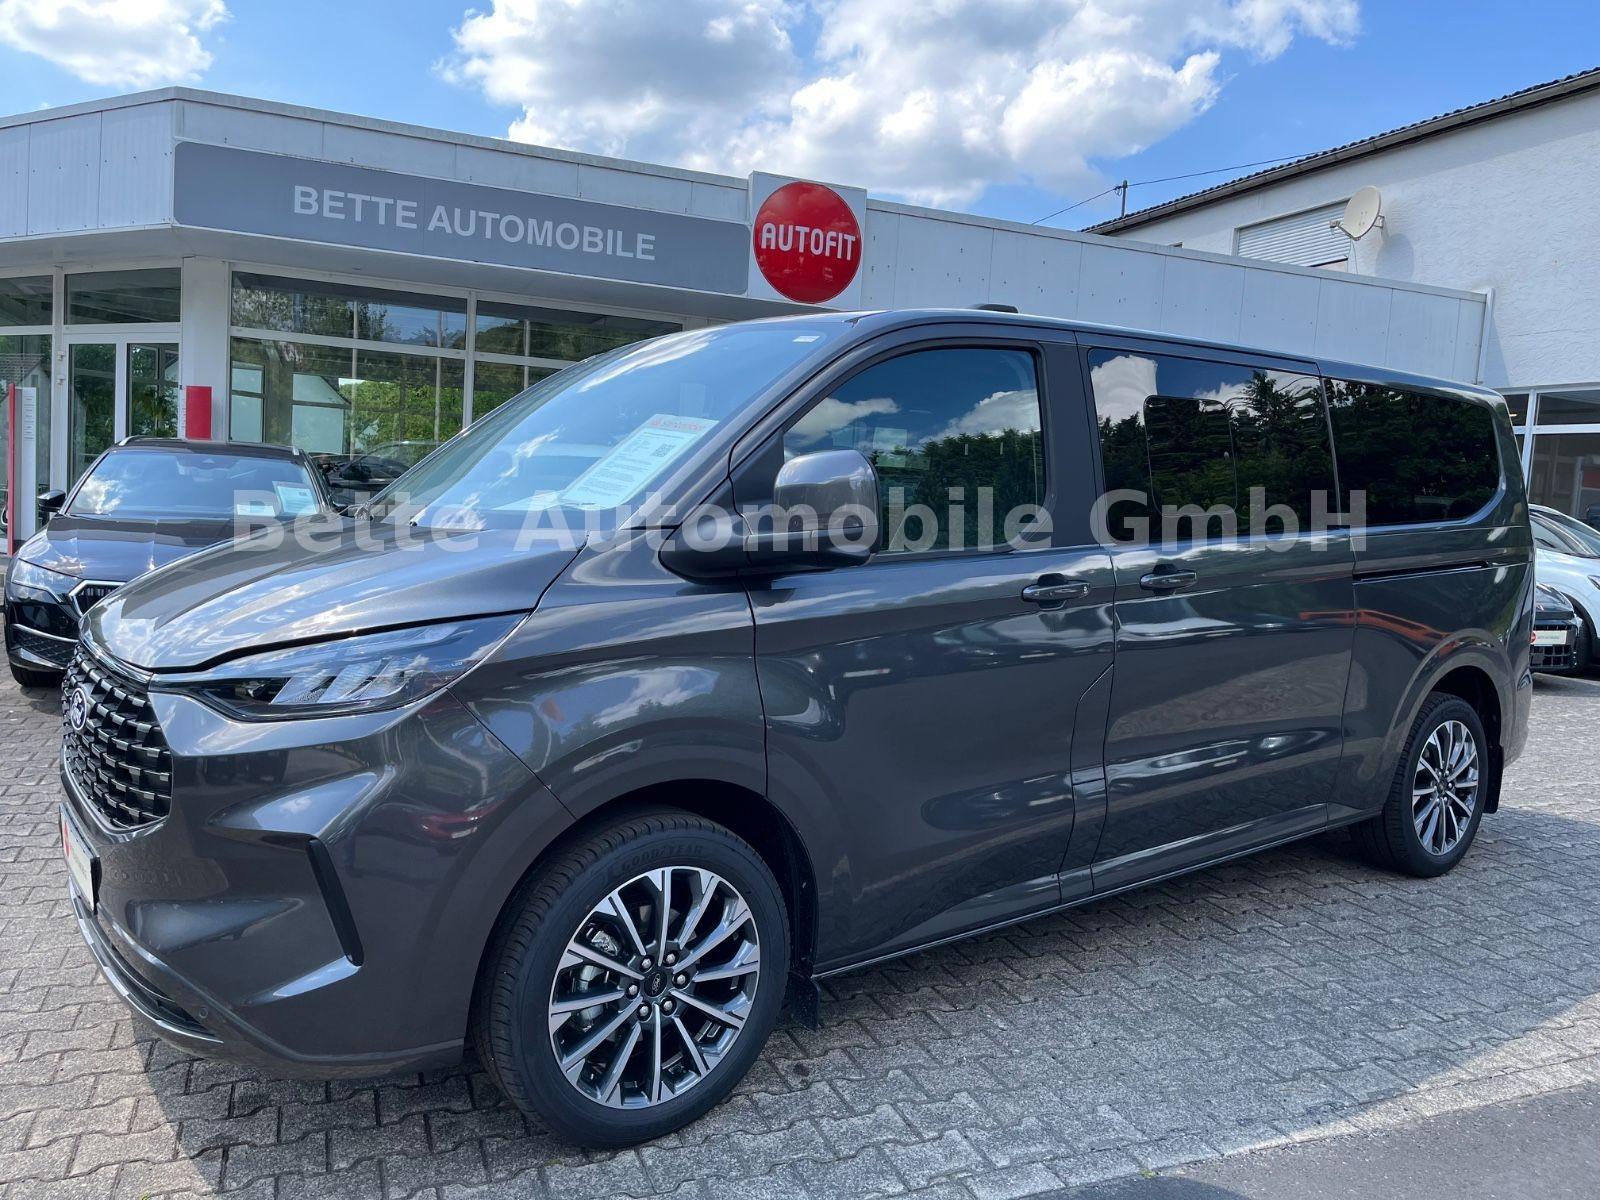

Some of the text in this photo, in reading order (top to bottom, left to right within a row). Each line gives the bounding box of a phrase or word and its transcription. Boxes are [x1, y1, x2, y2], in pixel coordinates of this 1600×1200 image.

[294, 185, 656, 261] BETTE AUTOMOBILE
[760, 222, 856, 261] AUTOFIT
